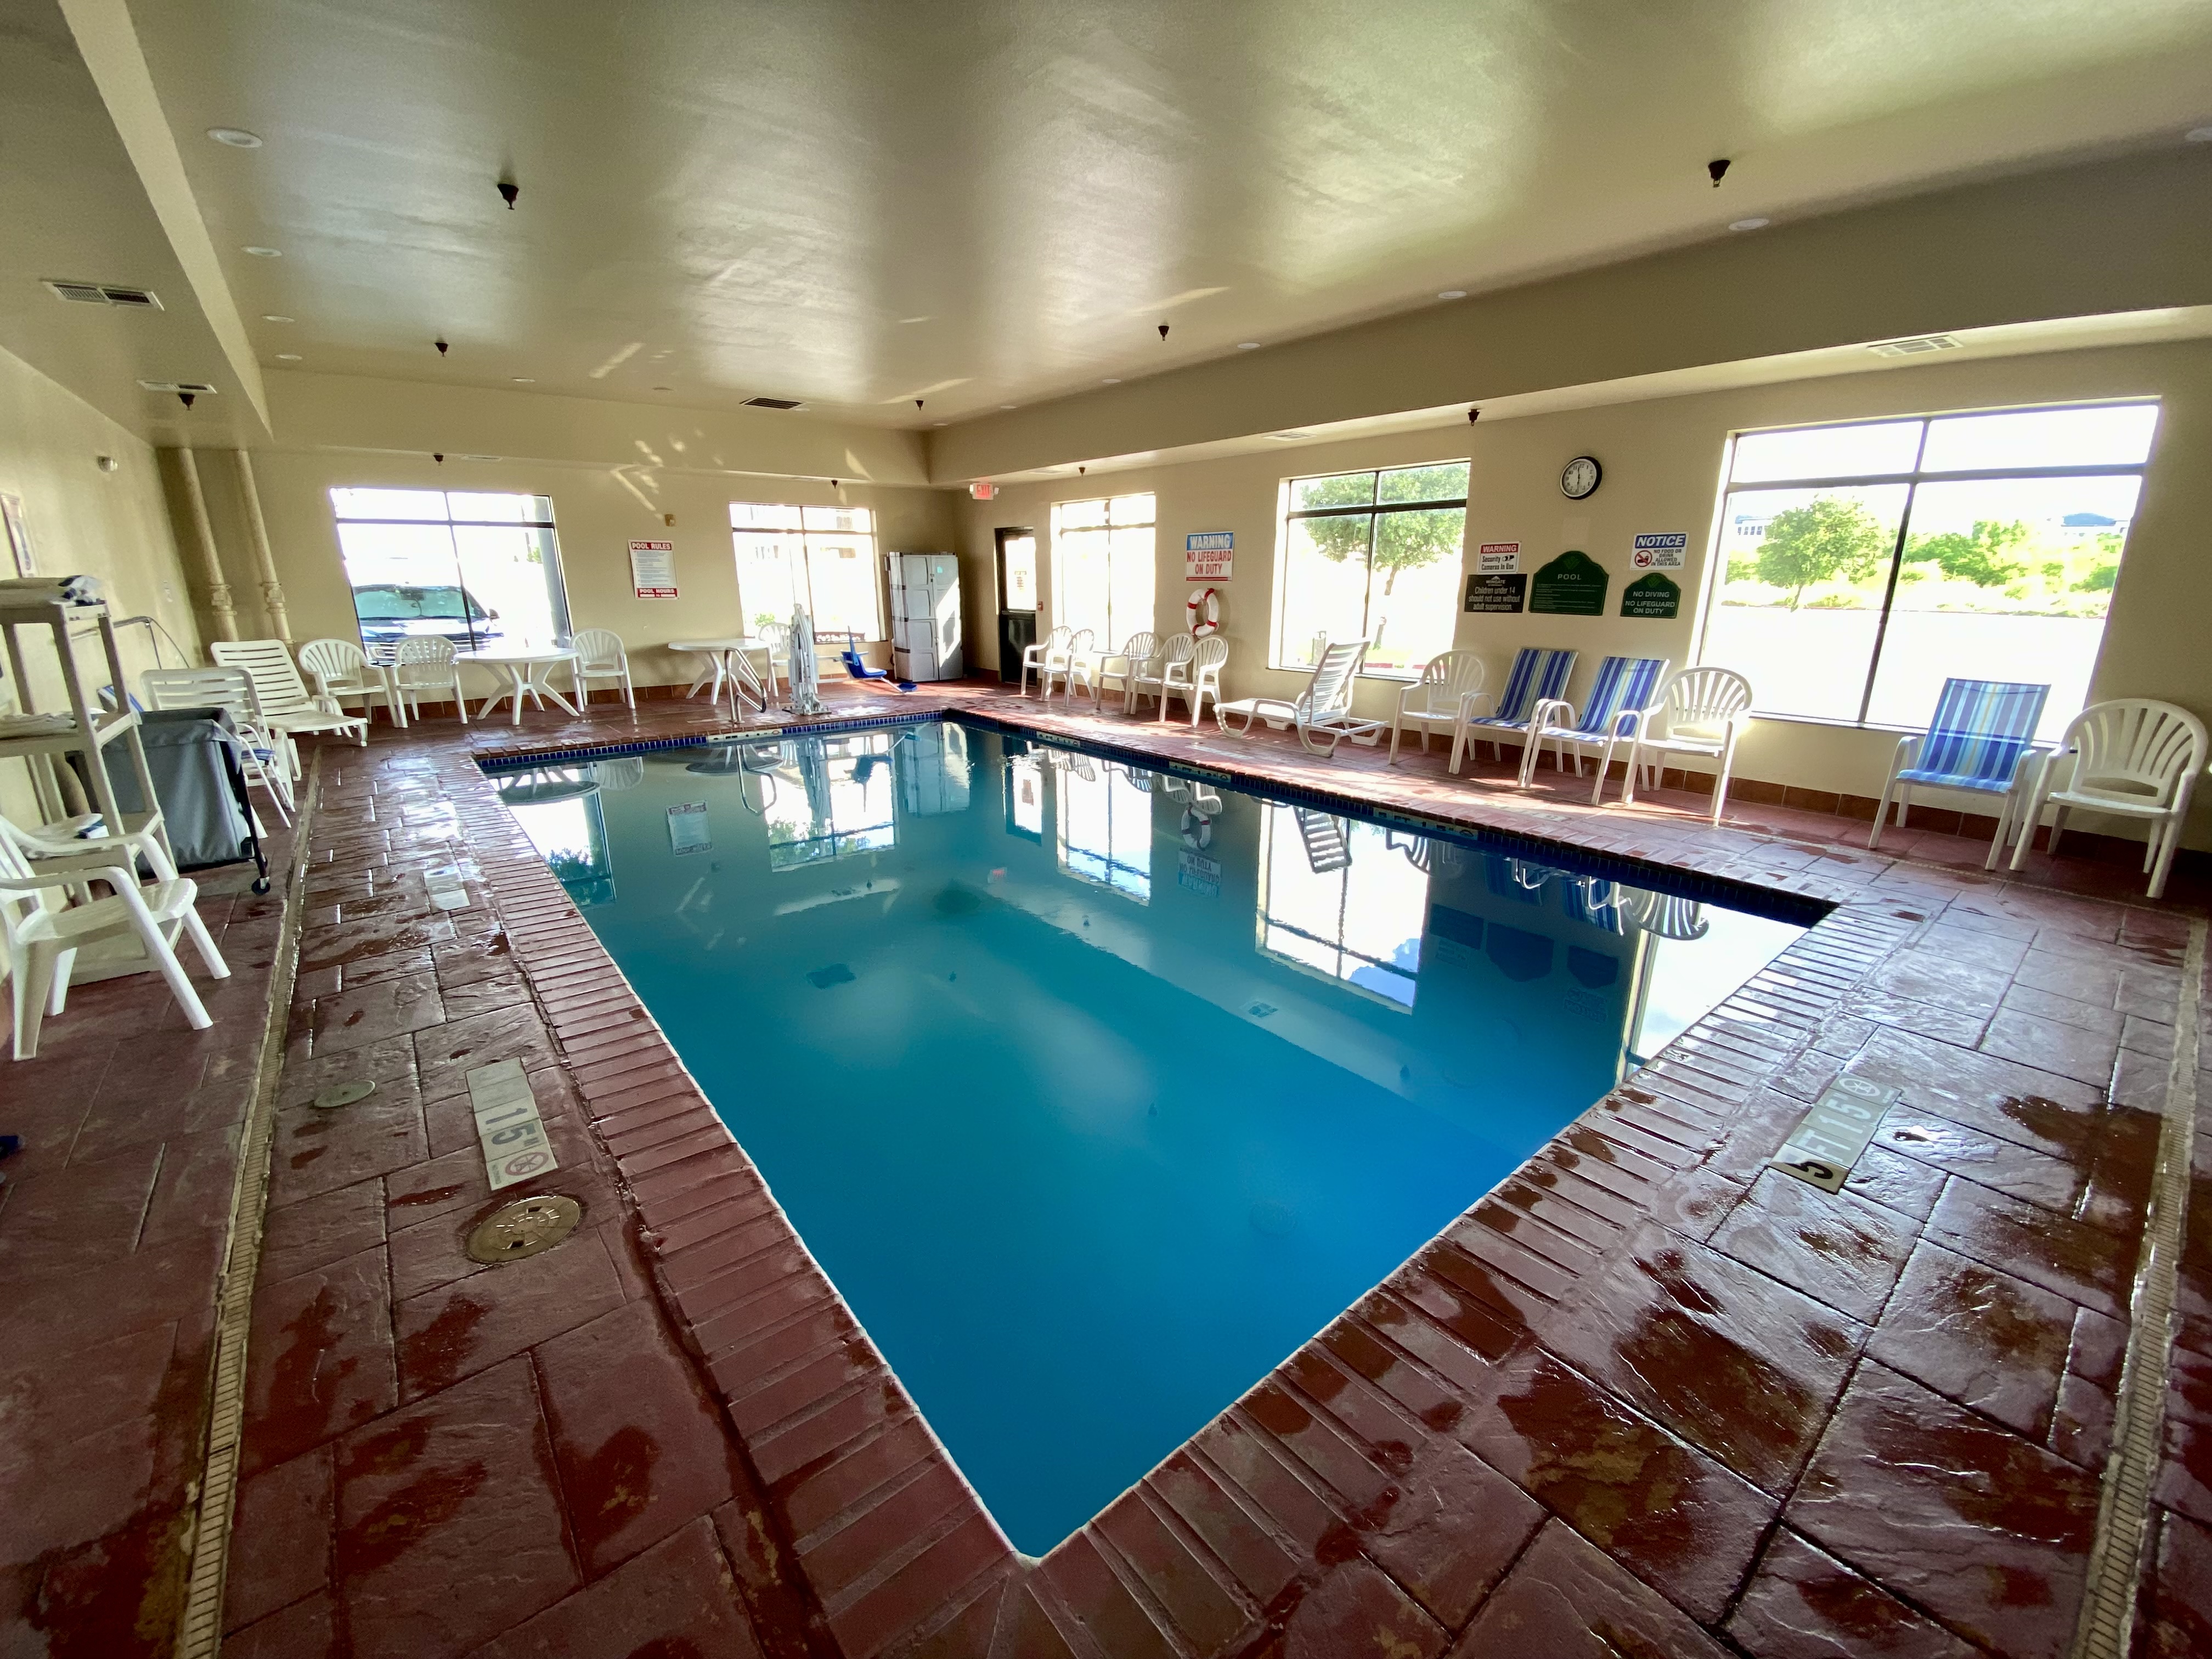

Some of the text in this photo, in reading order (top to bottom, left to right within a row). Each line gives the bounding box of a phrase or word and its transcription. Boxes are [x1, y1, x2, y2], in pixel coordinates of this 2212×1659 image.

[977, 484, 990, 494] EXIT
[1190, 534, 1230, 549] WARNING
[1637, 535, 1685, 546] NOTICE
[1482, 545, 1517, 553] WARNING
[1187, 550, 1231, 562] NO LIFEGUARD
[1195, 563, 1222, 574] ON DUTY
[1796, 1128, 1852, 1164] FT
[1784, 1154, 1833, 1180] 5
